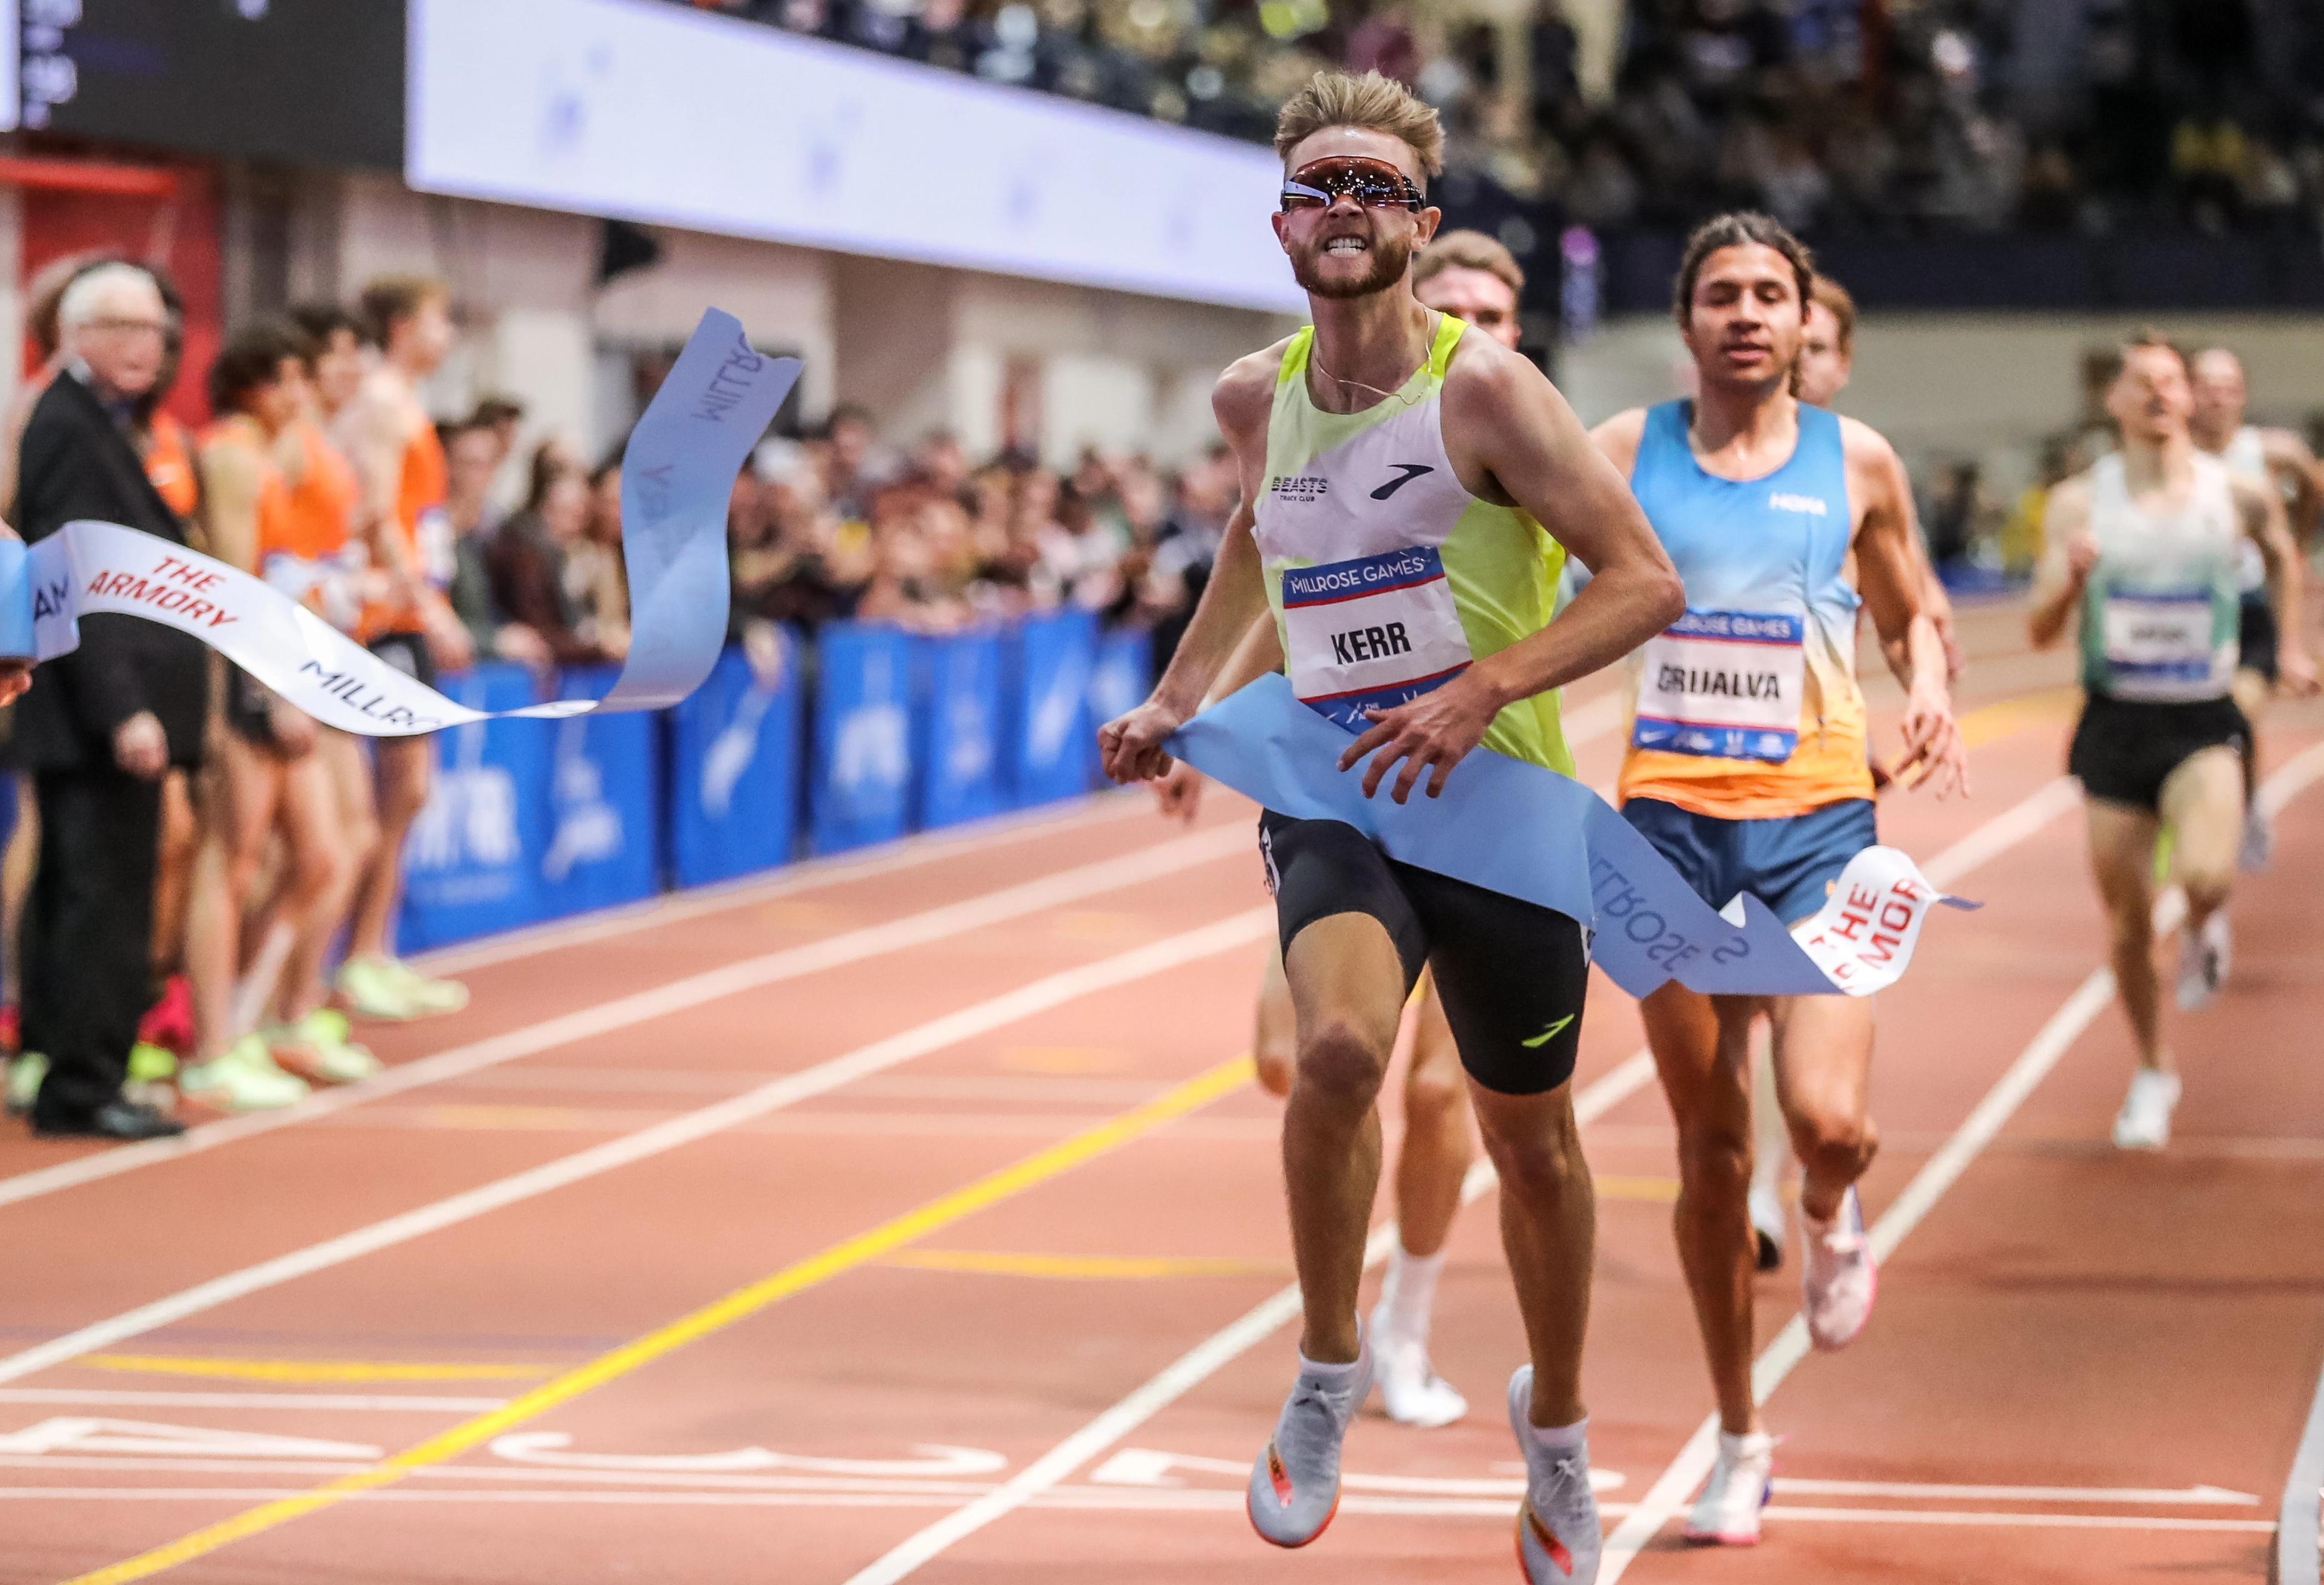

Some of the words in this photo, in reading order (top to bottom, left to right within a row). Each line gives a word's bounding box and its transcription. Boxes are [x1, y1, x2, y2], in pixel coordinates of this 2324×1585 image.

[1271, 477, 1328, 493] BEASTS
[152, 556, 226, 593] THE
[1291, 569, 1360, 594] MILLROSE
[1364, 557, 1424, 582] GAMES
[86, 570, 239, 628] ARMORY
[1331, 622, 1412, 665] KERR
